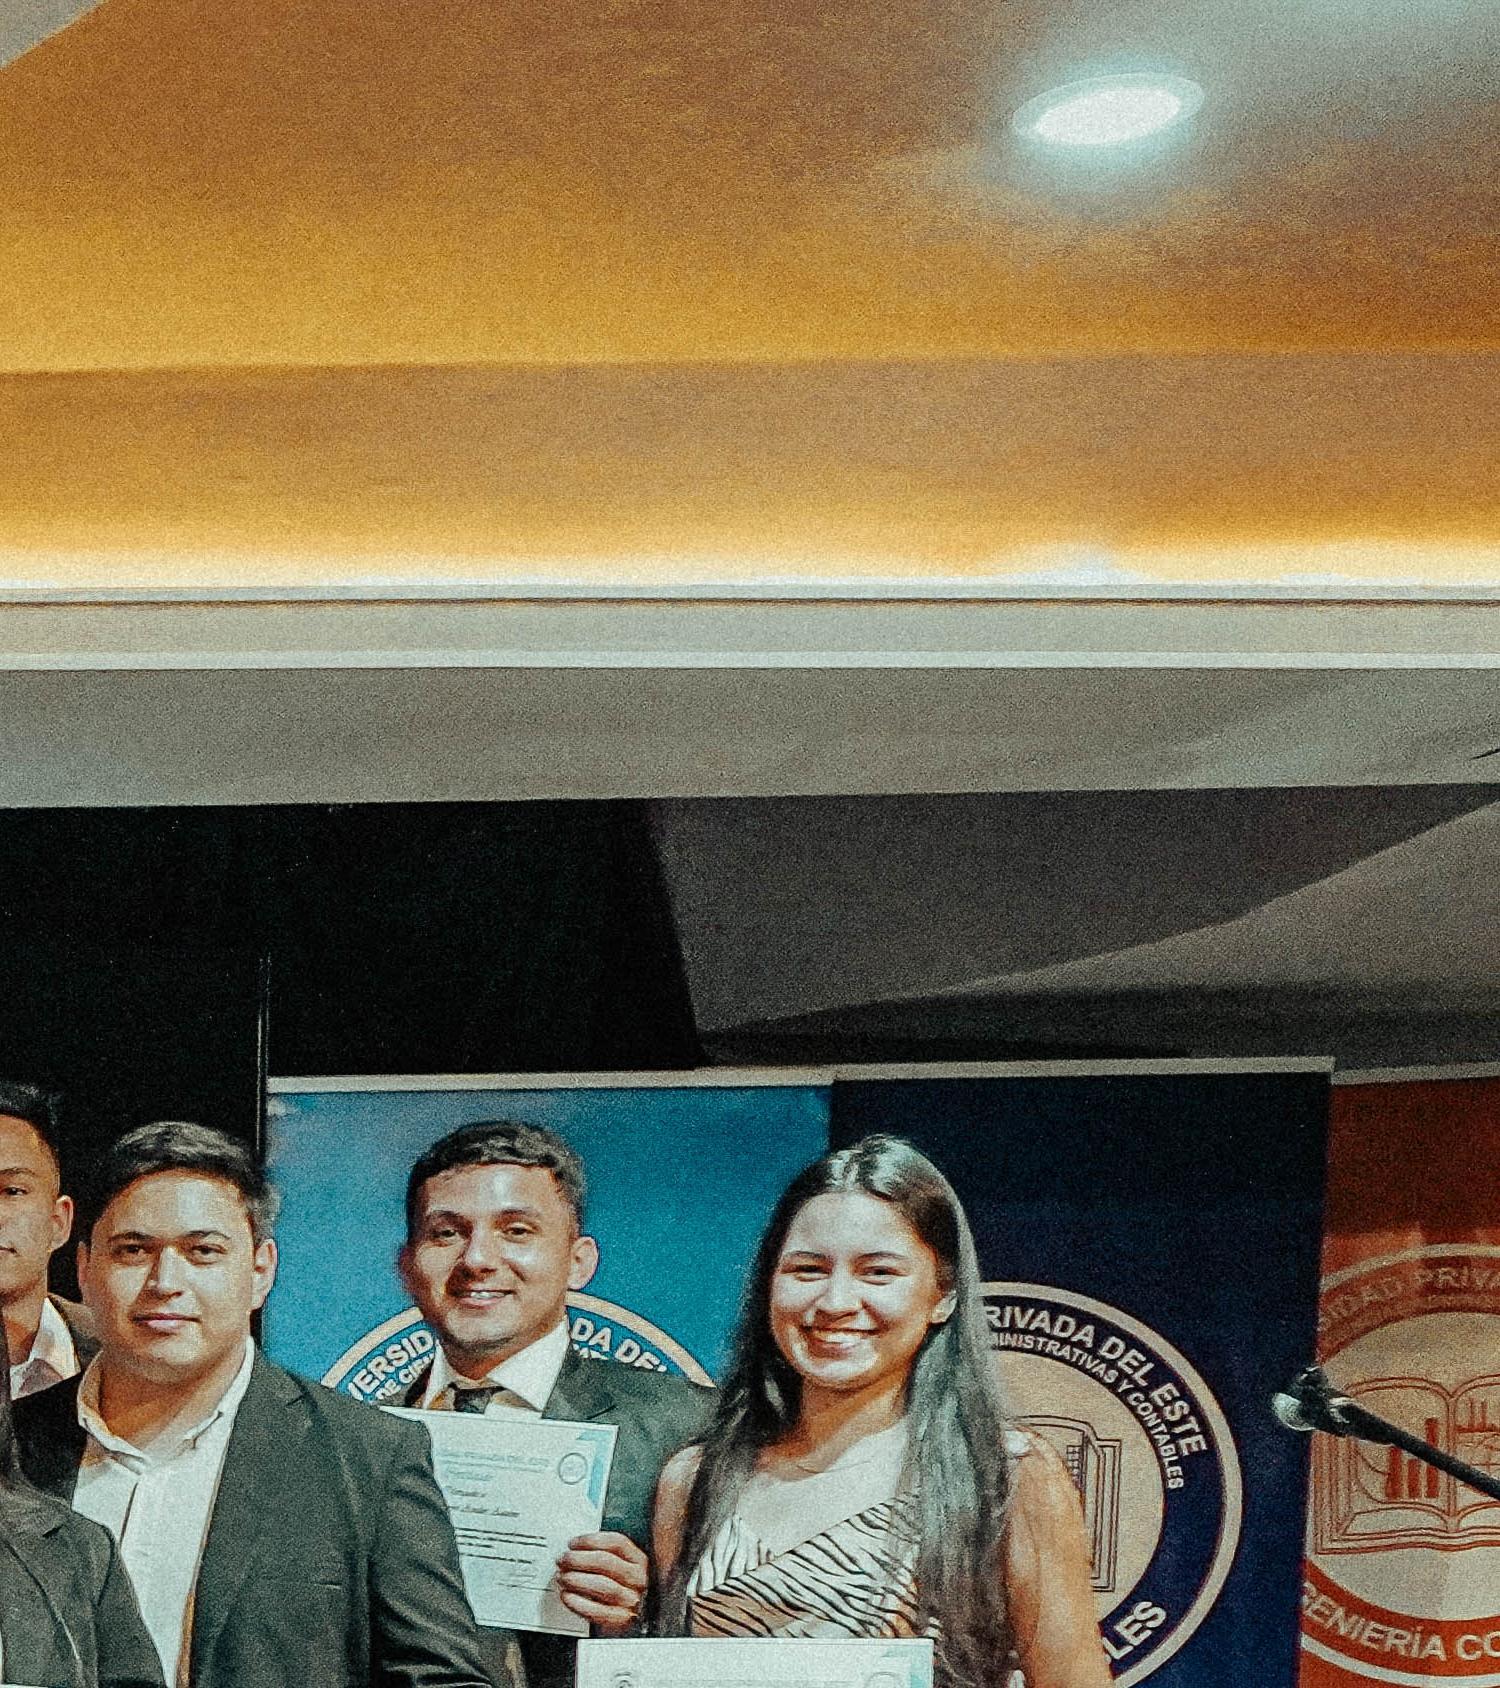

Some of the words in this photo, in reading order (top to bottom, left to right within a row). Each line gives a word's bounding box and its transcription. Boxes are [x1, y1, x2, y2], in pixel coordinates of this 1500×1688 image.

[1100, 1335, 1155, 1387] DEL
[1150, 1381, 1208, 1457] ESTE
[1117, 1379, 1135, 1394] Y
[1129, 1392, 1185, 1491] CONTABLES
[1101, 1601, 1167, 1664] LES
